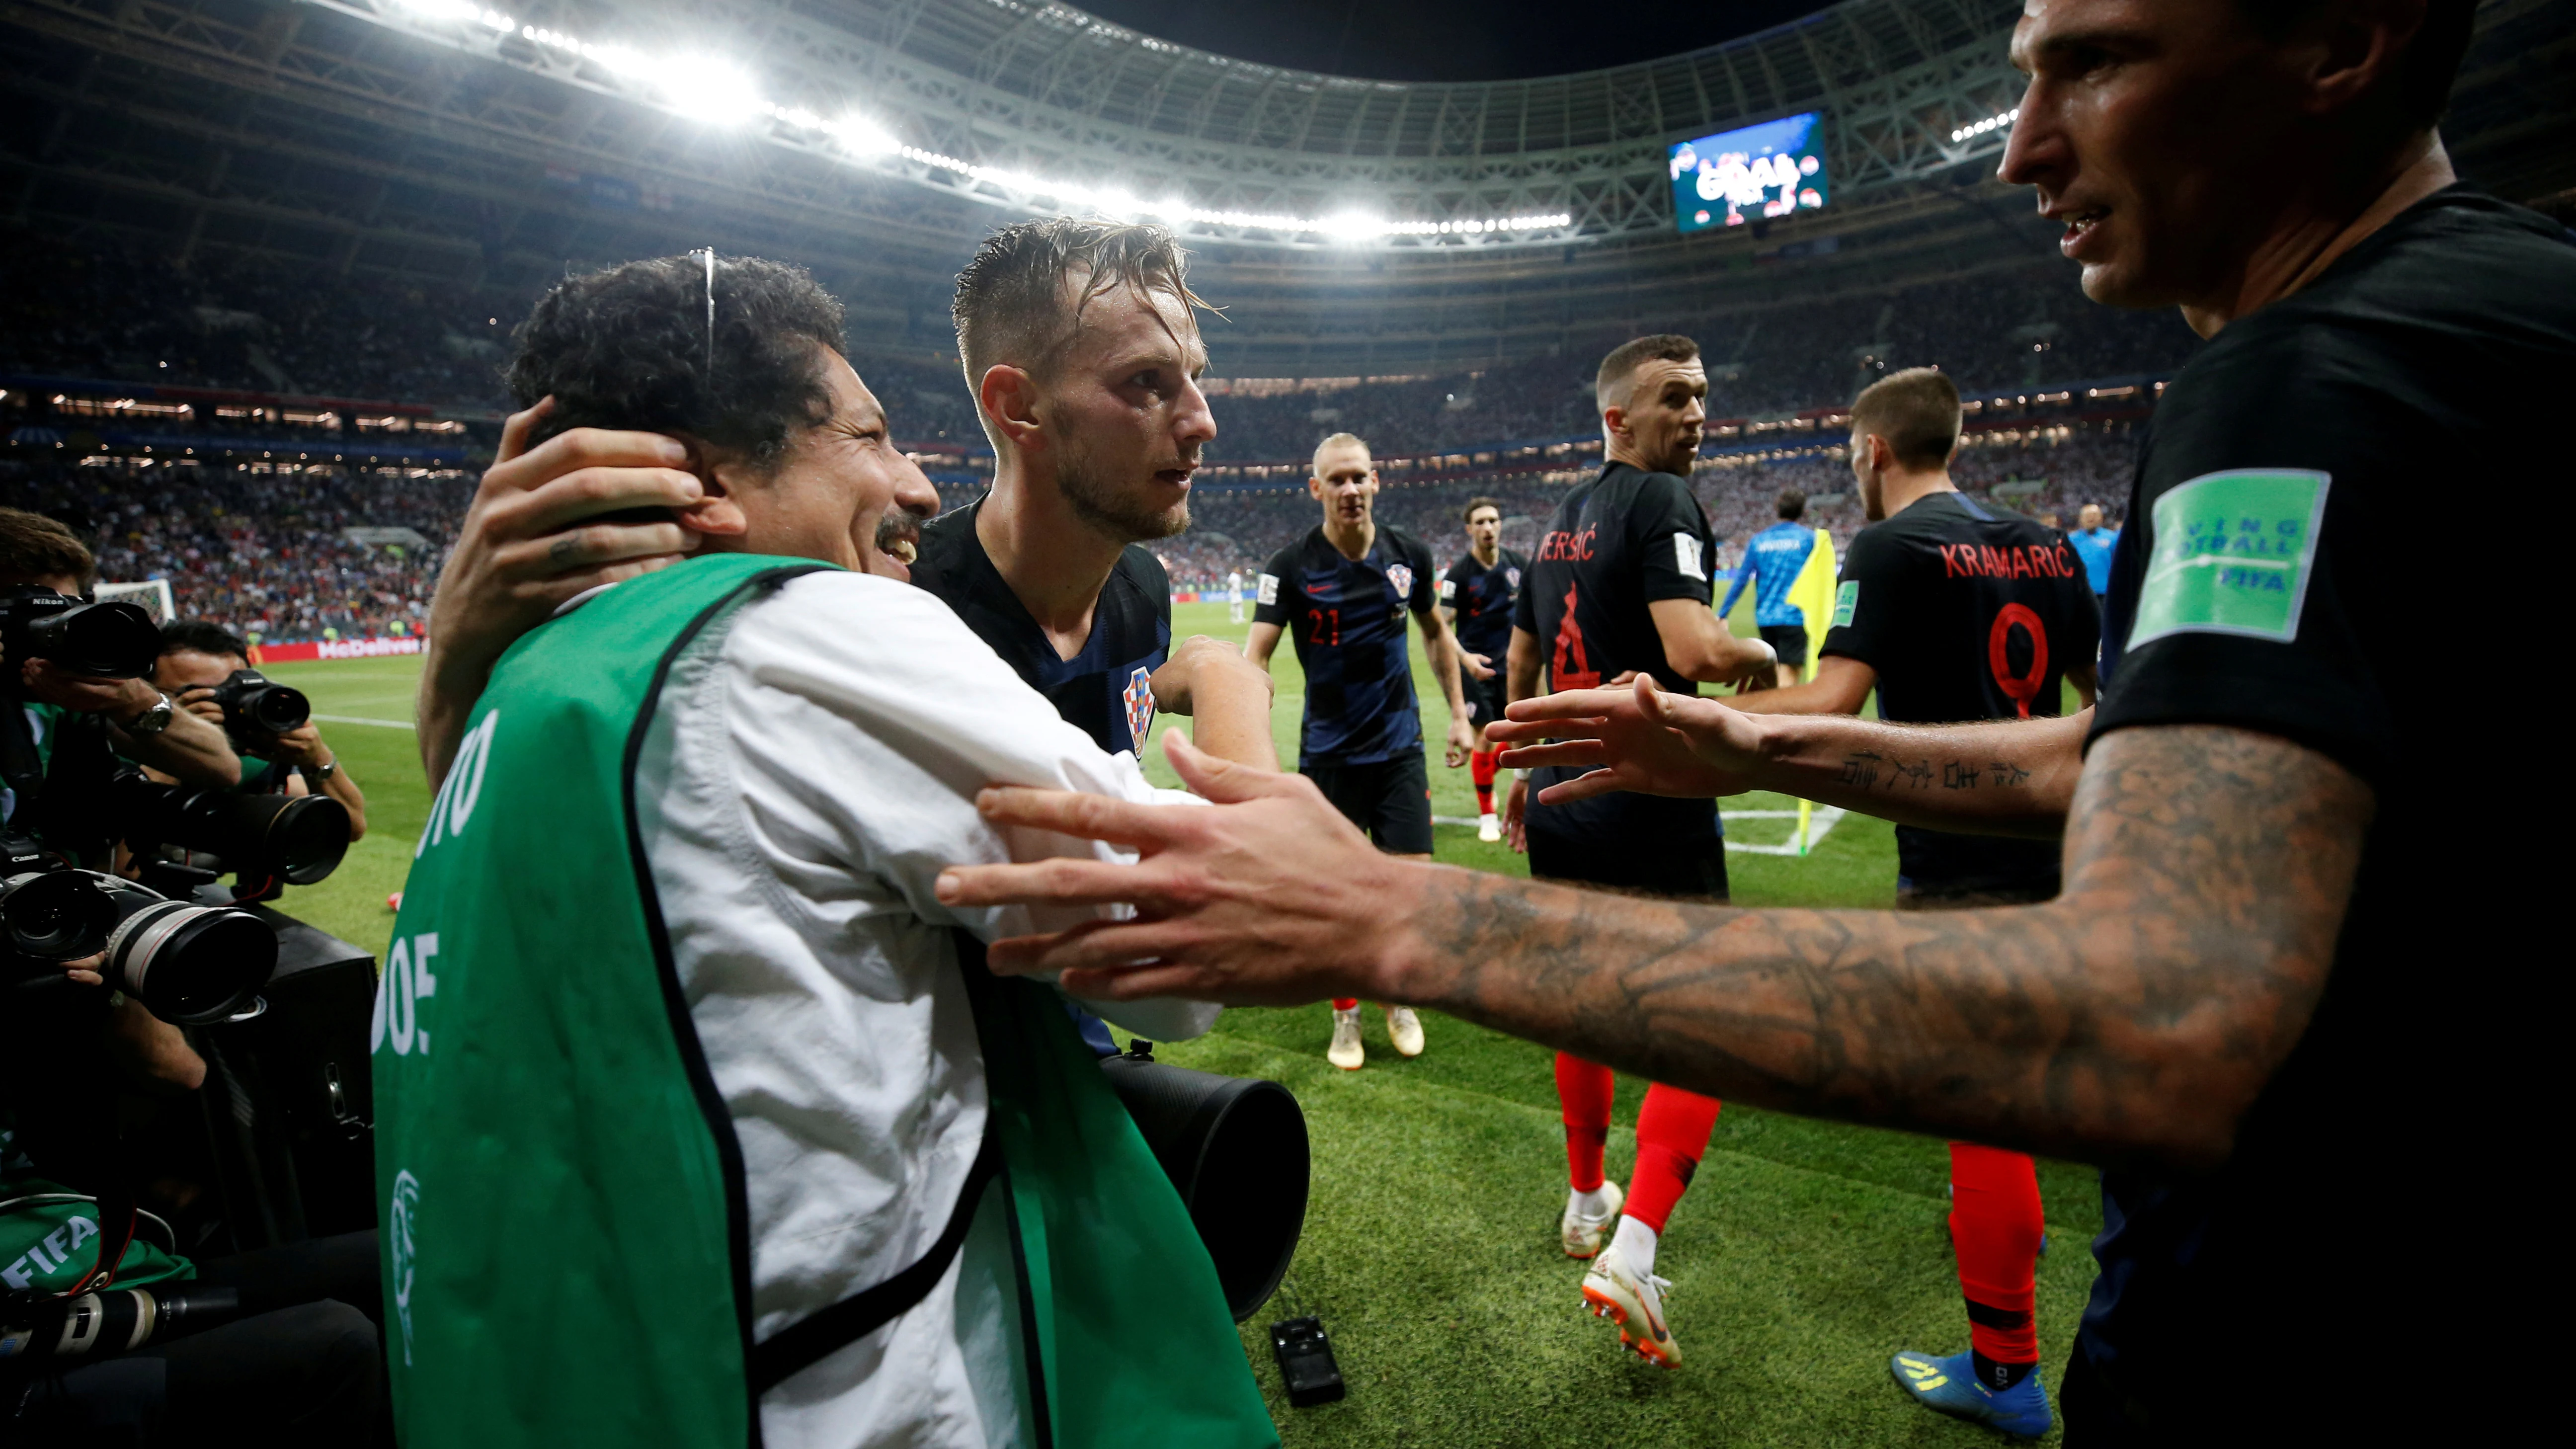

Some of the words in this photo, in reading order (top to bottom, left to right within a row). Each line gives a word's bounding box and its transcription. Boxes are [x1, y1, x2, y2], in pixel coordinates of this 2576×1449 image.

[1940, 538, 2074, 579] KRAMARIĆ
[2220, 568, 2285, 592] FIFA
[1308, 609, 1339, 646] 21
[317, 637, 430, 659] McDeliver
[1988, 602, 2048, 719] 9
[11, 854, 40, 862] Canon
[0, 1215, 98, 1289] FIFA
